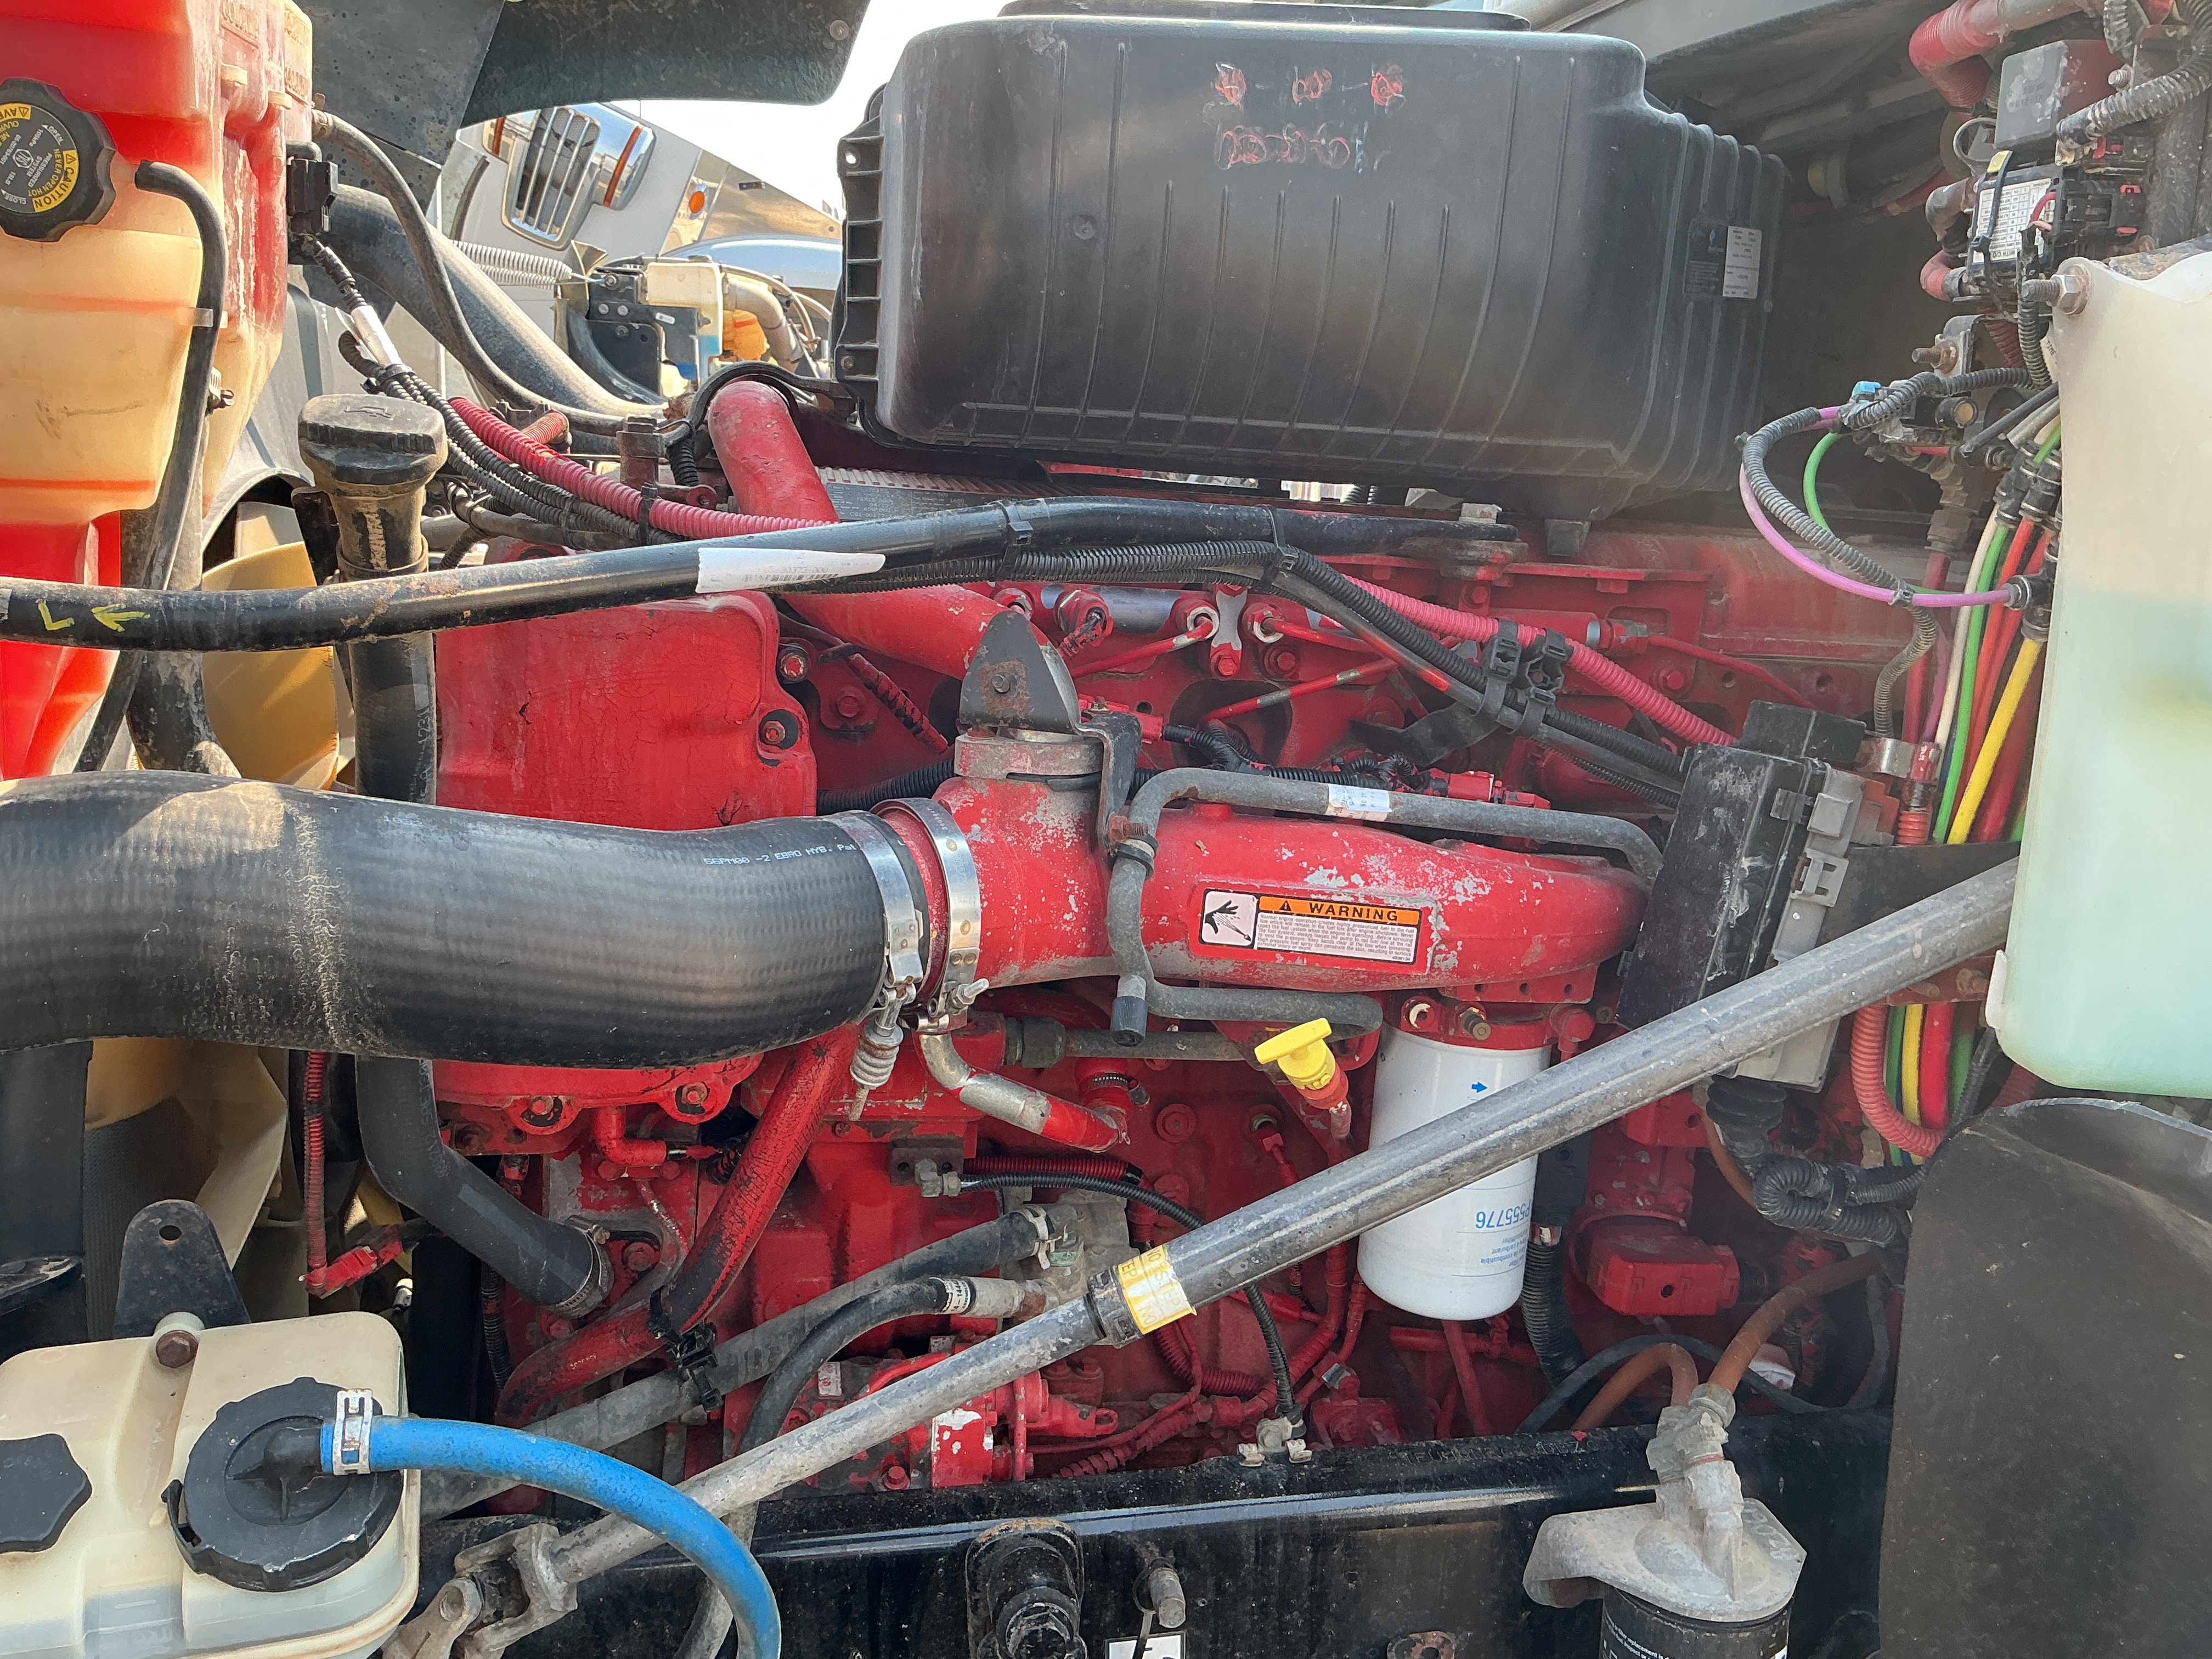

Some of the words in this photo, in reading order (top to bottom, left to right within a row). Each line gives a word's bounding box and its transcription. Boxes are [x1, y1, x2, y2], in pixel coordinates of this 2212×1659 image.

[48, 126, 64, 143] OPEN
[26, 155, 42, 177] SYSTEM
[28, 153, 53, 188] PRESSURIZED
[53, 148, 63, 177] NEVER
[27, 188, 43, 197] HOT
[35, 167, 75, 208] CAUTION
[43, 174, 59, 193] OPEN
[4, 195, 27, 205] CLOSE
[774, 850, 803, 861] EBRO
[1309, 902, 1399, 922] WARNING
[1475, 1199, 1532, 1229] P555776
[1146, 1248, 1162, 1262] NO
[1480, 1253, 1513, 1264] combustible
[1627, 1637, 1658, 1658] replacement
